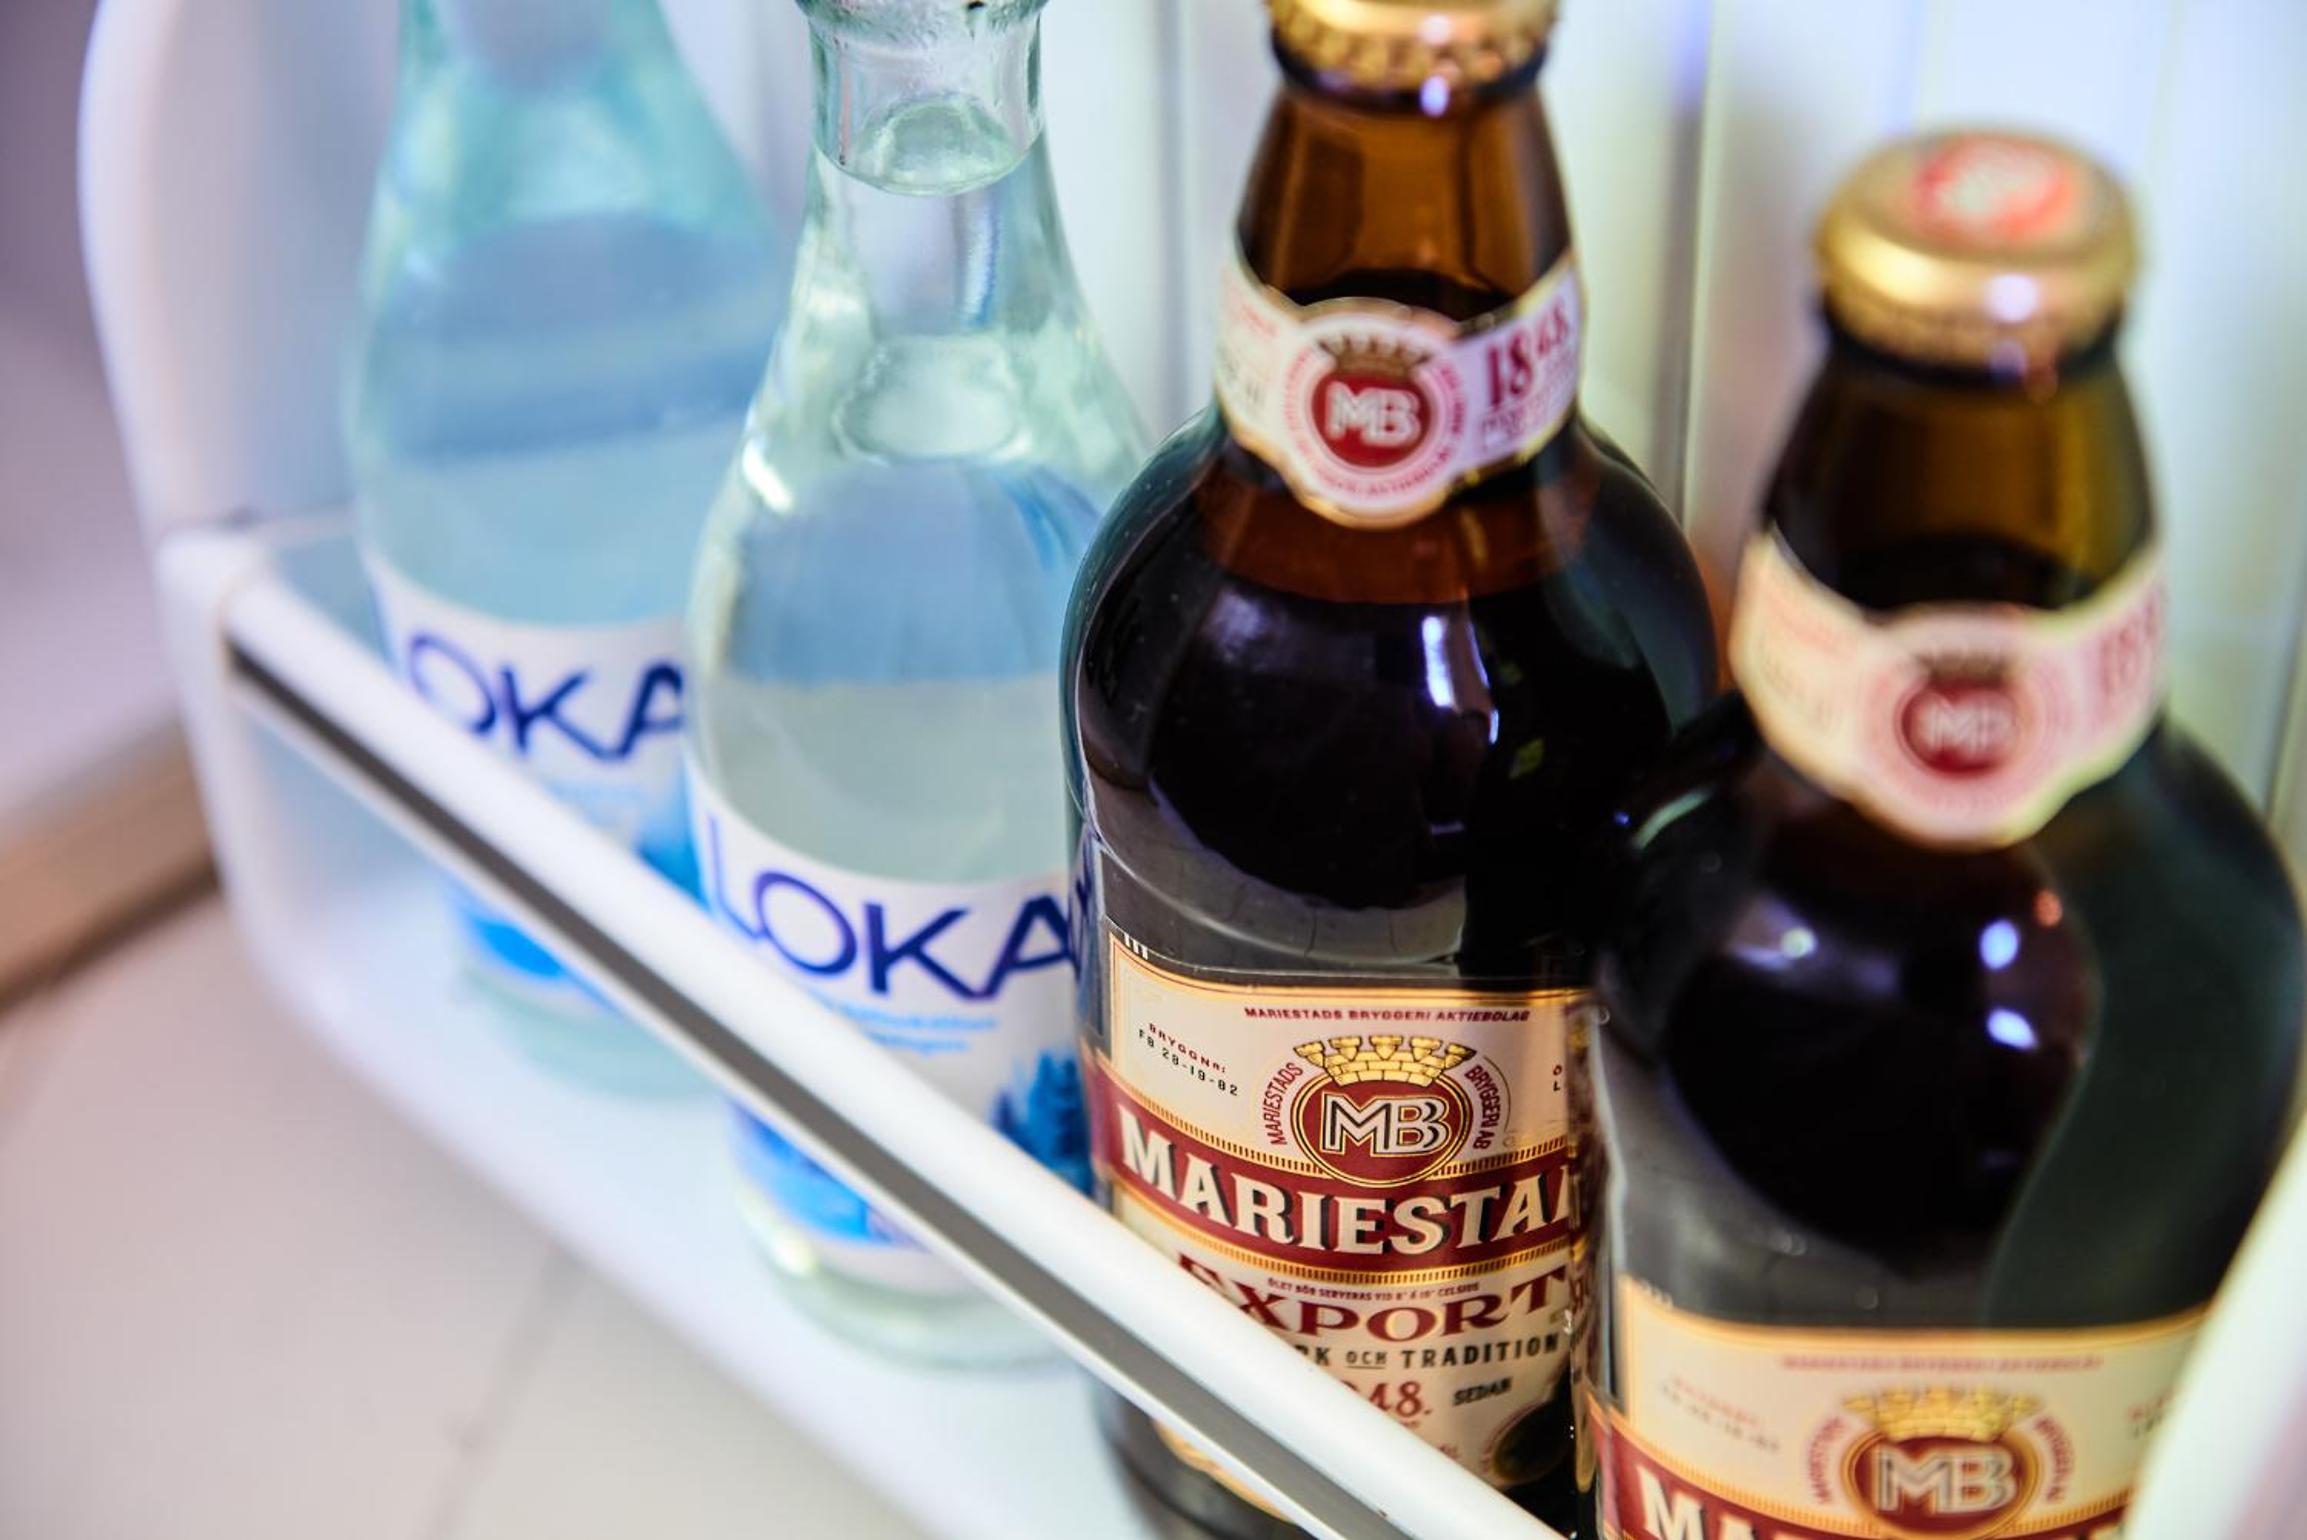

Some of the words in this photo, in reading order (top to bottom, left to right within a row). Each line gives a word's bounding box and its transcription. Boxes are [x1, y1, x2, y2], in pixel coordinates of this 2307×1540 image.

[1324, 380, 1422, 448] MB
[405, 632, 684, 764] OKA
[710, 815, 1082, 1006] LOKA
[1244, 1007, 1343, 1021] MARIESTADS
[1349, 1010, 1431, 1022] BRYGGERI
[1437, 1010, 1531, 1023] AKTIEBOLAG
[1262, 1062, 1304, 1147] MARIESTADS
[1320, 1090, 1452, 1157] MB
[1472, 1129, 1496, 1151] AB
[1345, 1350, 1388, 1368] OCH
[1402, 1333, 1559, 1369] TRADITION
[1872, 1444, 2018, 1514] MB
